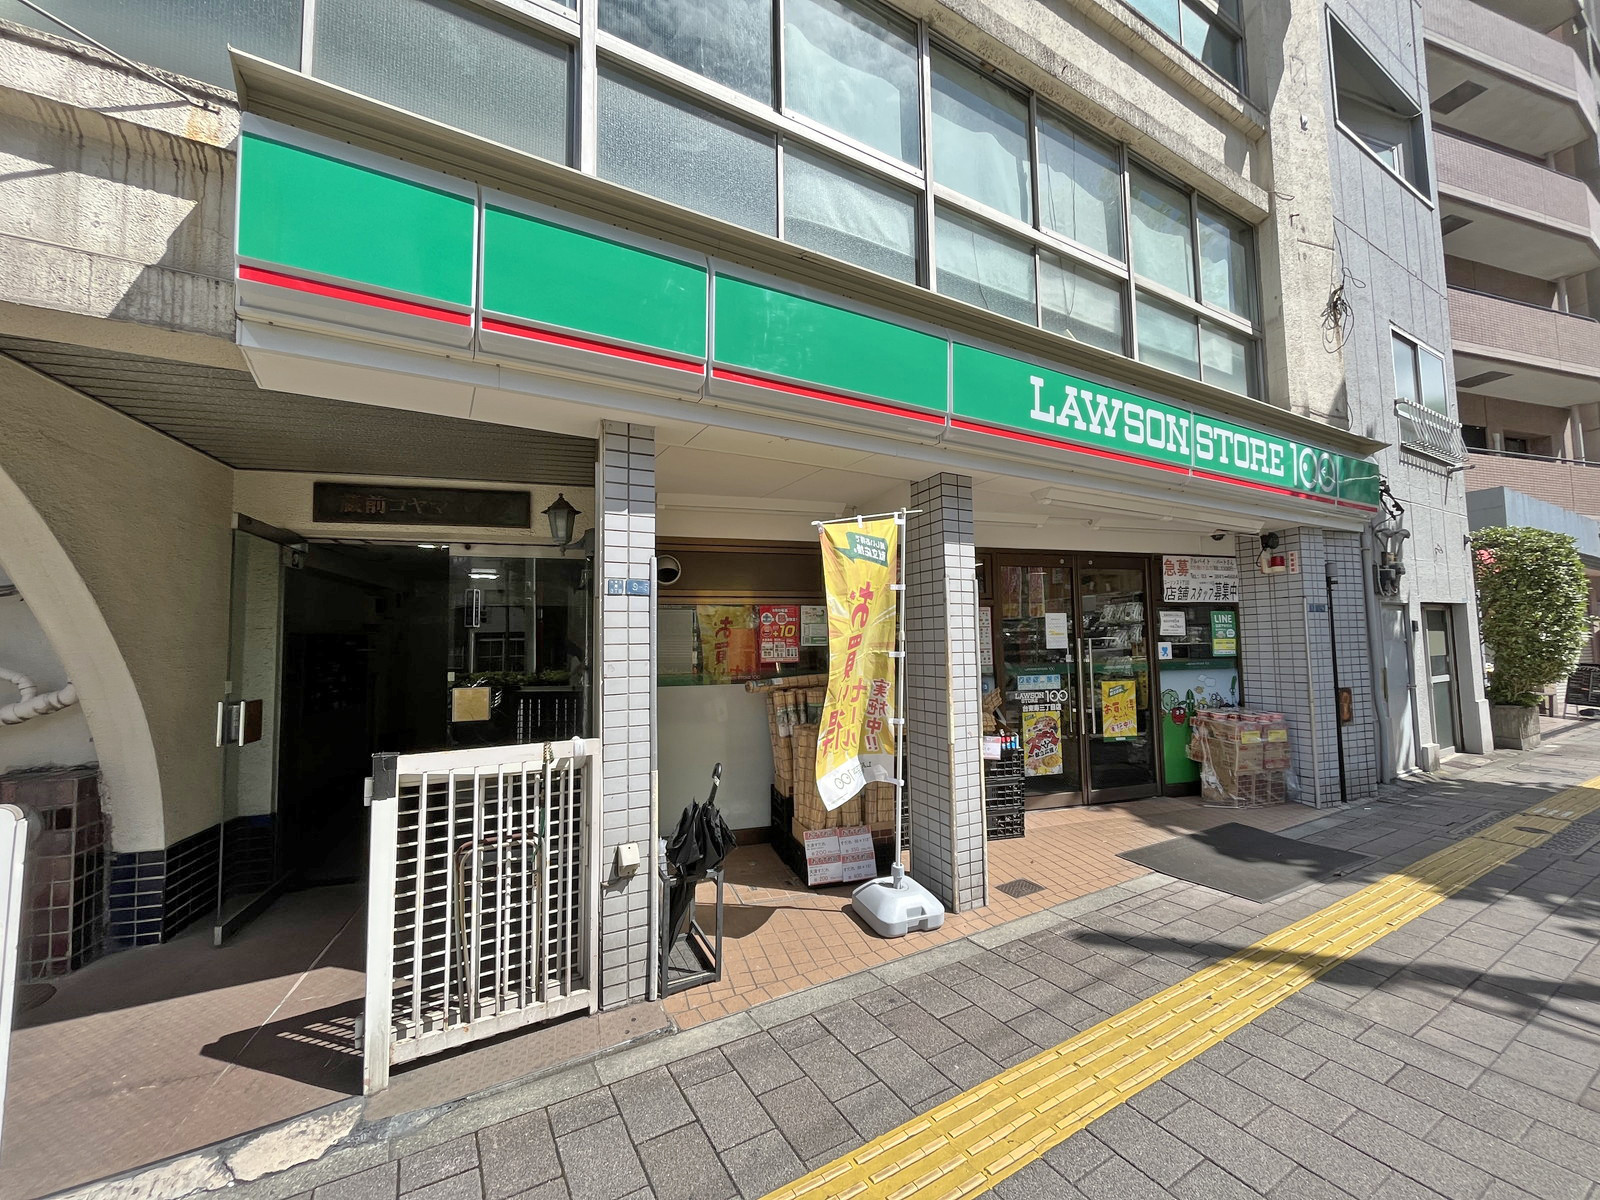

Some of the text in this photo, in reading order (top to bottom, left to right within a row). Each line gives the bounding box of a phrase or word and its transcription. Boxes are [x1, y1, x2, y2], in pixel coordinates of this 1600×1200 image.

[1029, 375, 1338, 493] LAWSON STORE 100
[1164, 558, 1189, 577] 急募
[1213, 614, 1233, 624] LINE
[1015, 691, 1045, 700] LAWSON
[1045, 689, 1068, 703] 100
